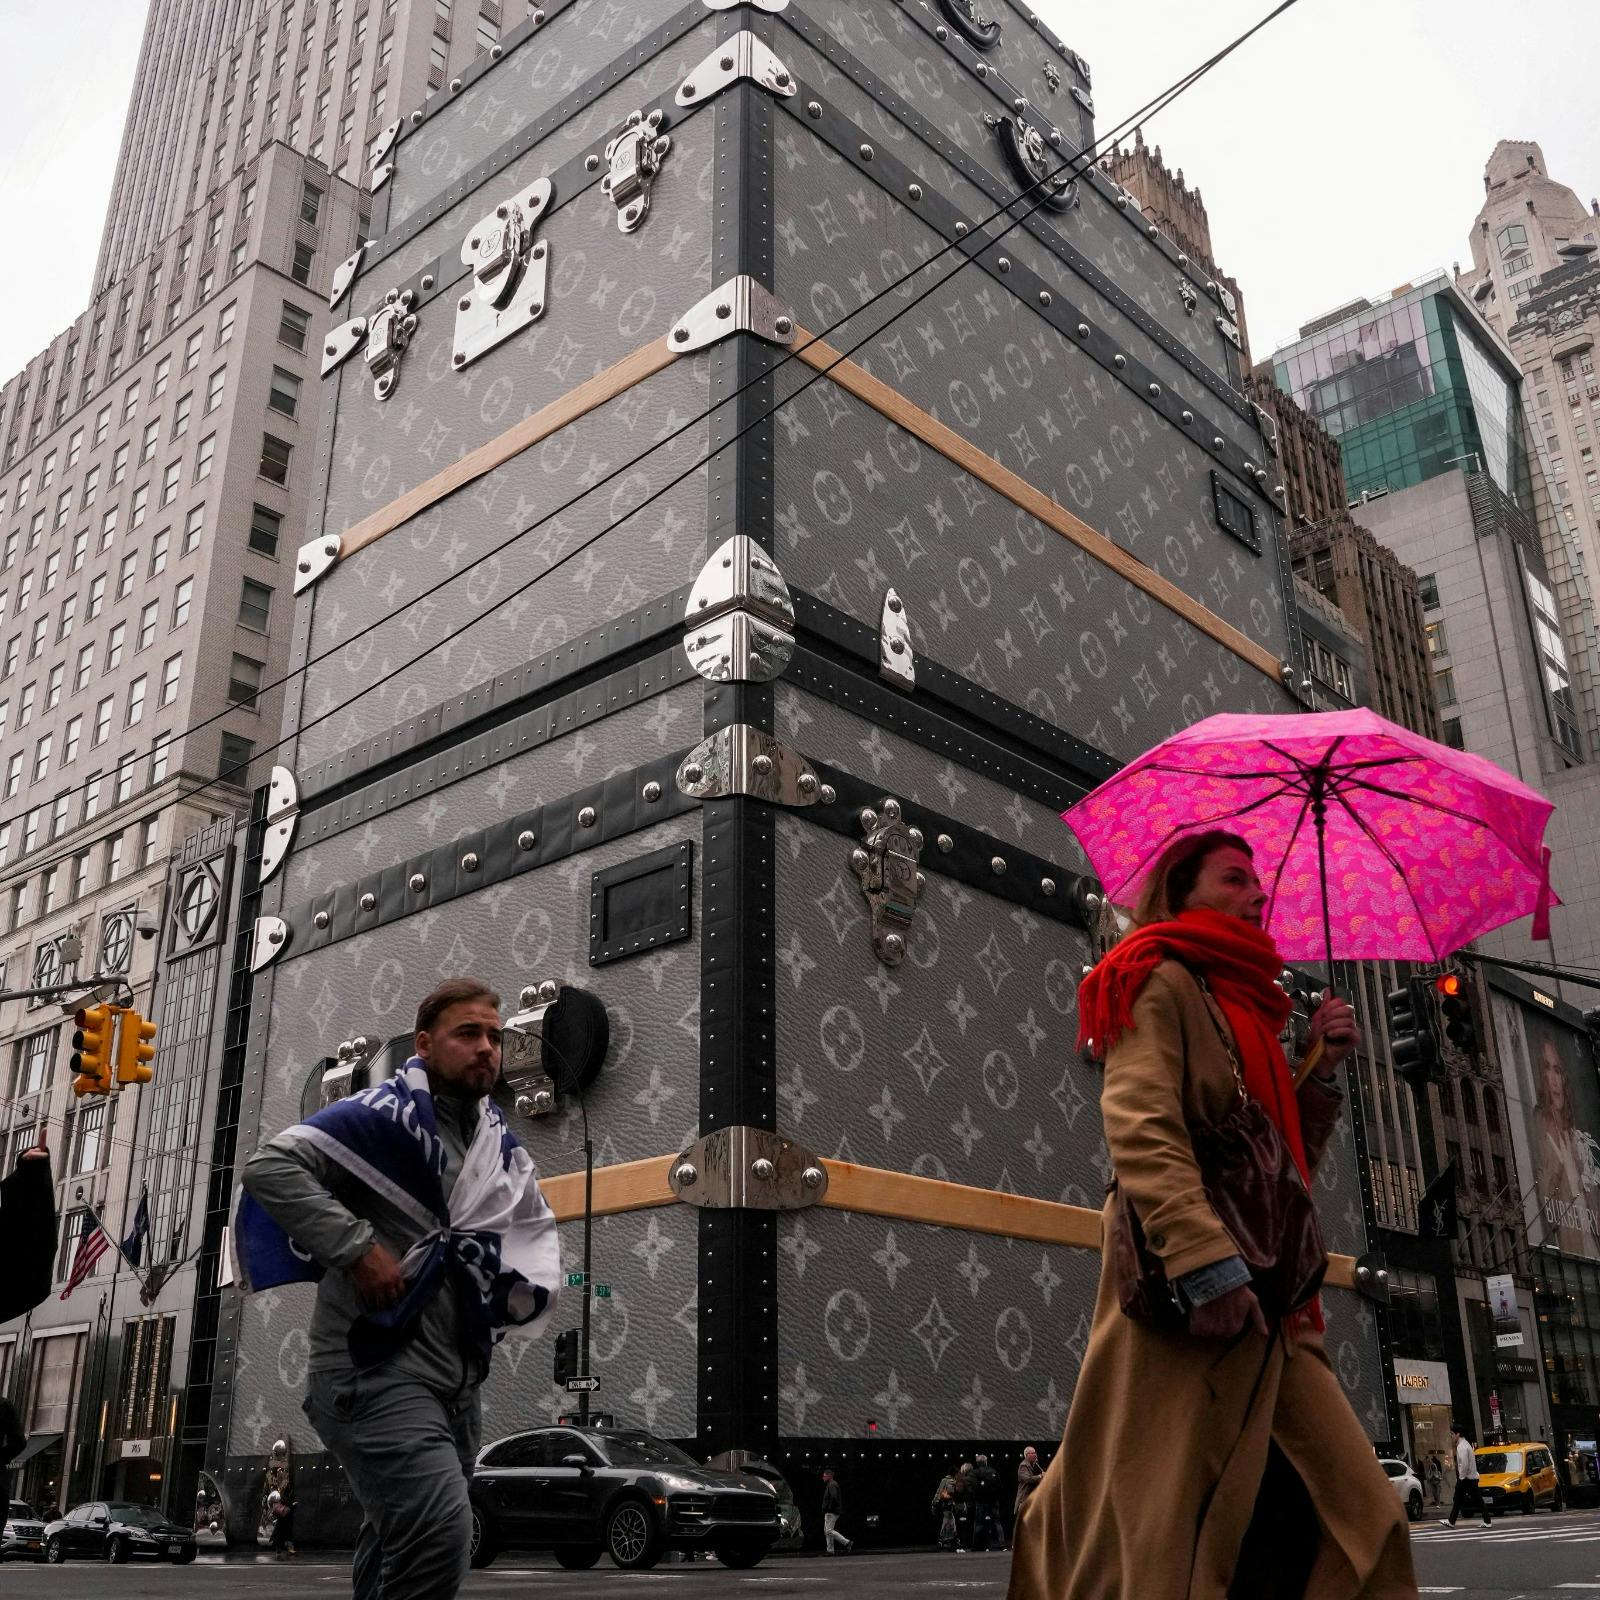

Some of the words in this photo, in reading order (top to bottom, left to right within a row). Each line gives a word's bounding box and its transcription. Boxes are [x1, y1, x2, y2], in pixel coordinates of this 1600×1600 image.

[1544, 1196, 1599, 1237] BURBERRY
[1499, 1335, 1520, 1343] PRADA
[571, 1381, 582, 1389] ONE
[586, 1381, 596, 1389] WAY
[1402, 1375, 1429, 1389] LAURENT
